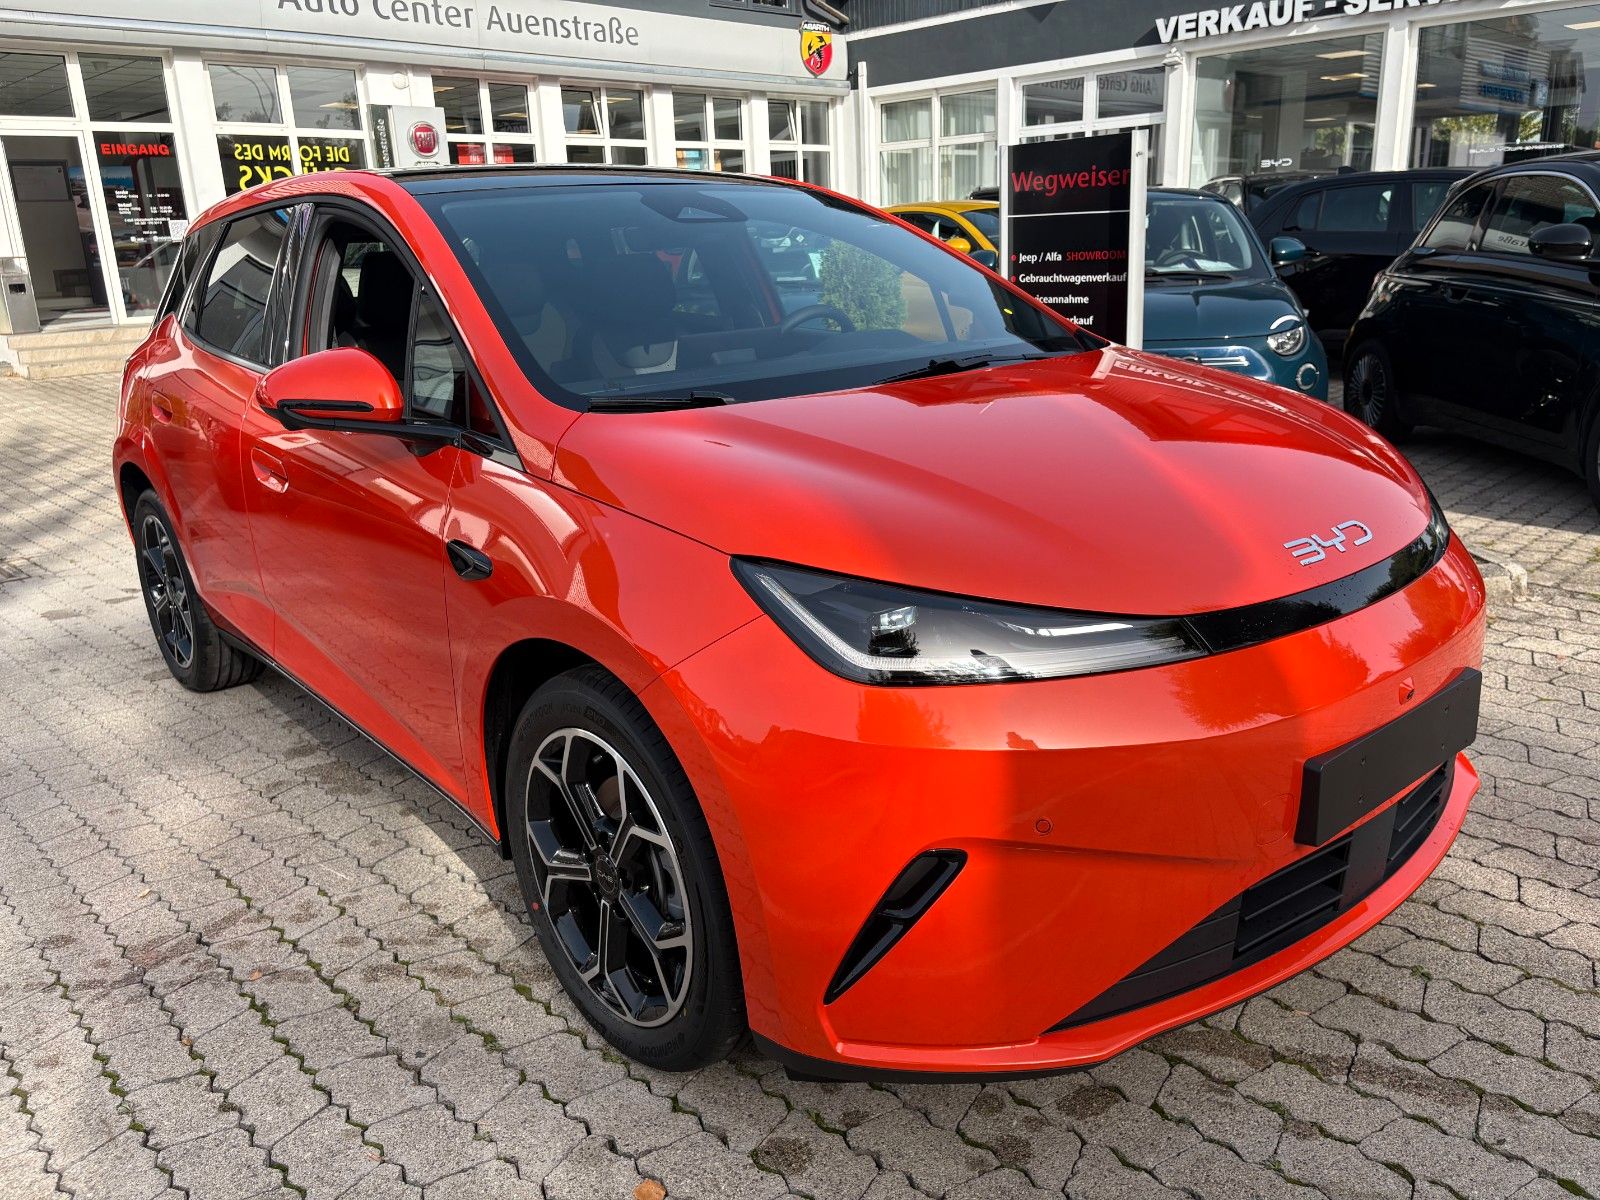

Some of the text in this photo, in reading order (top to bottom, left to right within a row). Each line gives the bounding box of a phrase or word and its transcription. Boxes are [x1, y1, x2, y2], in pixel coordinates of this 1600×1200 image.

[373, 0, 474, 28] Center
[486, 5, 639, 46] Auenstraße
[803, 22, 830, 32] ABARTH
[1155, 0, 1313, 44] VERKAUF
[100, 143, 170, 156] EINGANG
[377, 118, 390, 168] uenstraße
[1260, 157, 1293, 168] BYD
[1011, 164, 1131, 197] Wegweiser
[1019, 250, 1127, 264] Jeep / Alfa SHOWROOM
[1019, 272, 1128, 285] Gebrauchtwagenverkauf
[1283, 520, 1373, 566] BYD
